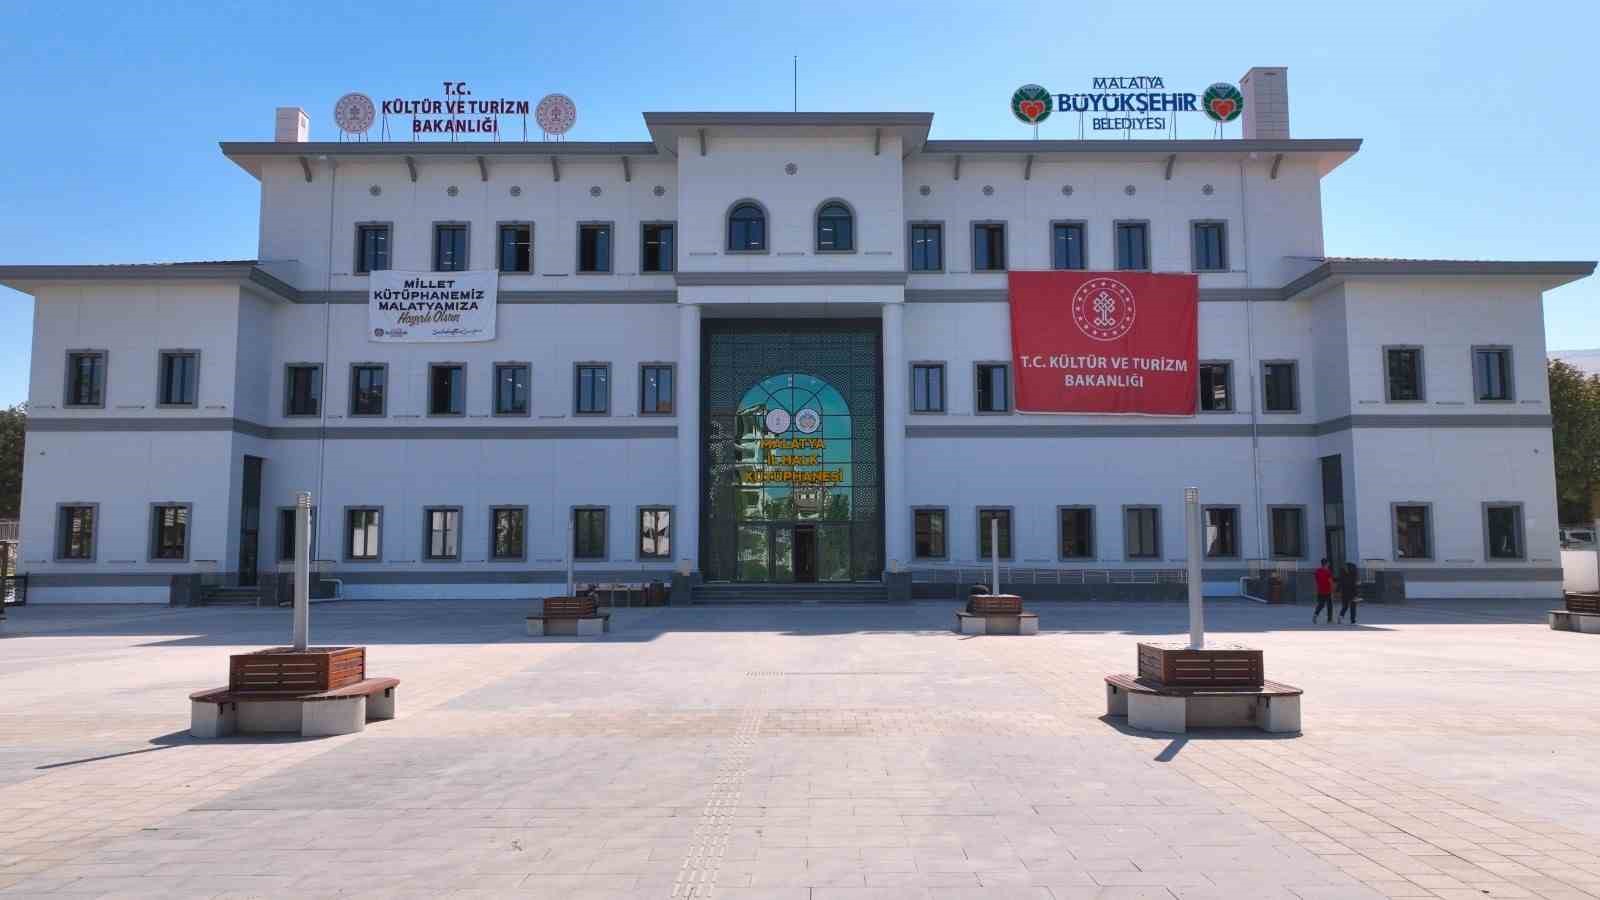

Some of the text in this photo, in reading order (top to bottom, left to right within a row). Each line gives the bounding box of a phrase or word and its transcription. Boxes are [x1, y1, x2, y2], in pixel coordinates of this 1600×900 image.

[443, 82, 471, 95] T.C.
[1093, 76, 1164, 89] MALATYA
[382, 98, 529, 114] KÜLTÜR VE TURİZM
[412, 117, 498, 133] BAKANLIĞI
[404, 277, 456, 289] MİLLET
[374, 288, 485, 300] KÜTÜPHANEMİZ
[378, 302, 479, 311] MALATYAMIZA
[1020, 354, 1188, 372] T.C. KÜLTÜR VE TURİZM
[1064, 373, 1144, 388] BAKANLIĞI
[760, 438, 825, 449] MALATYA
